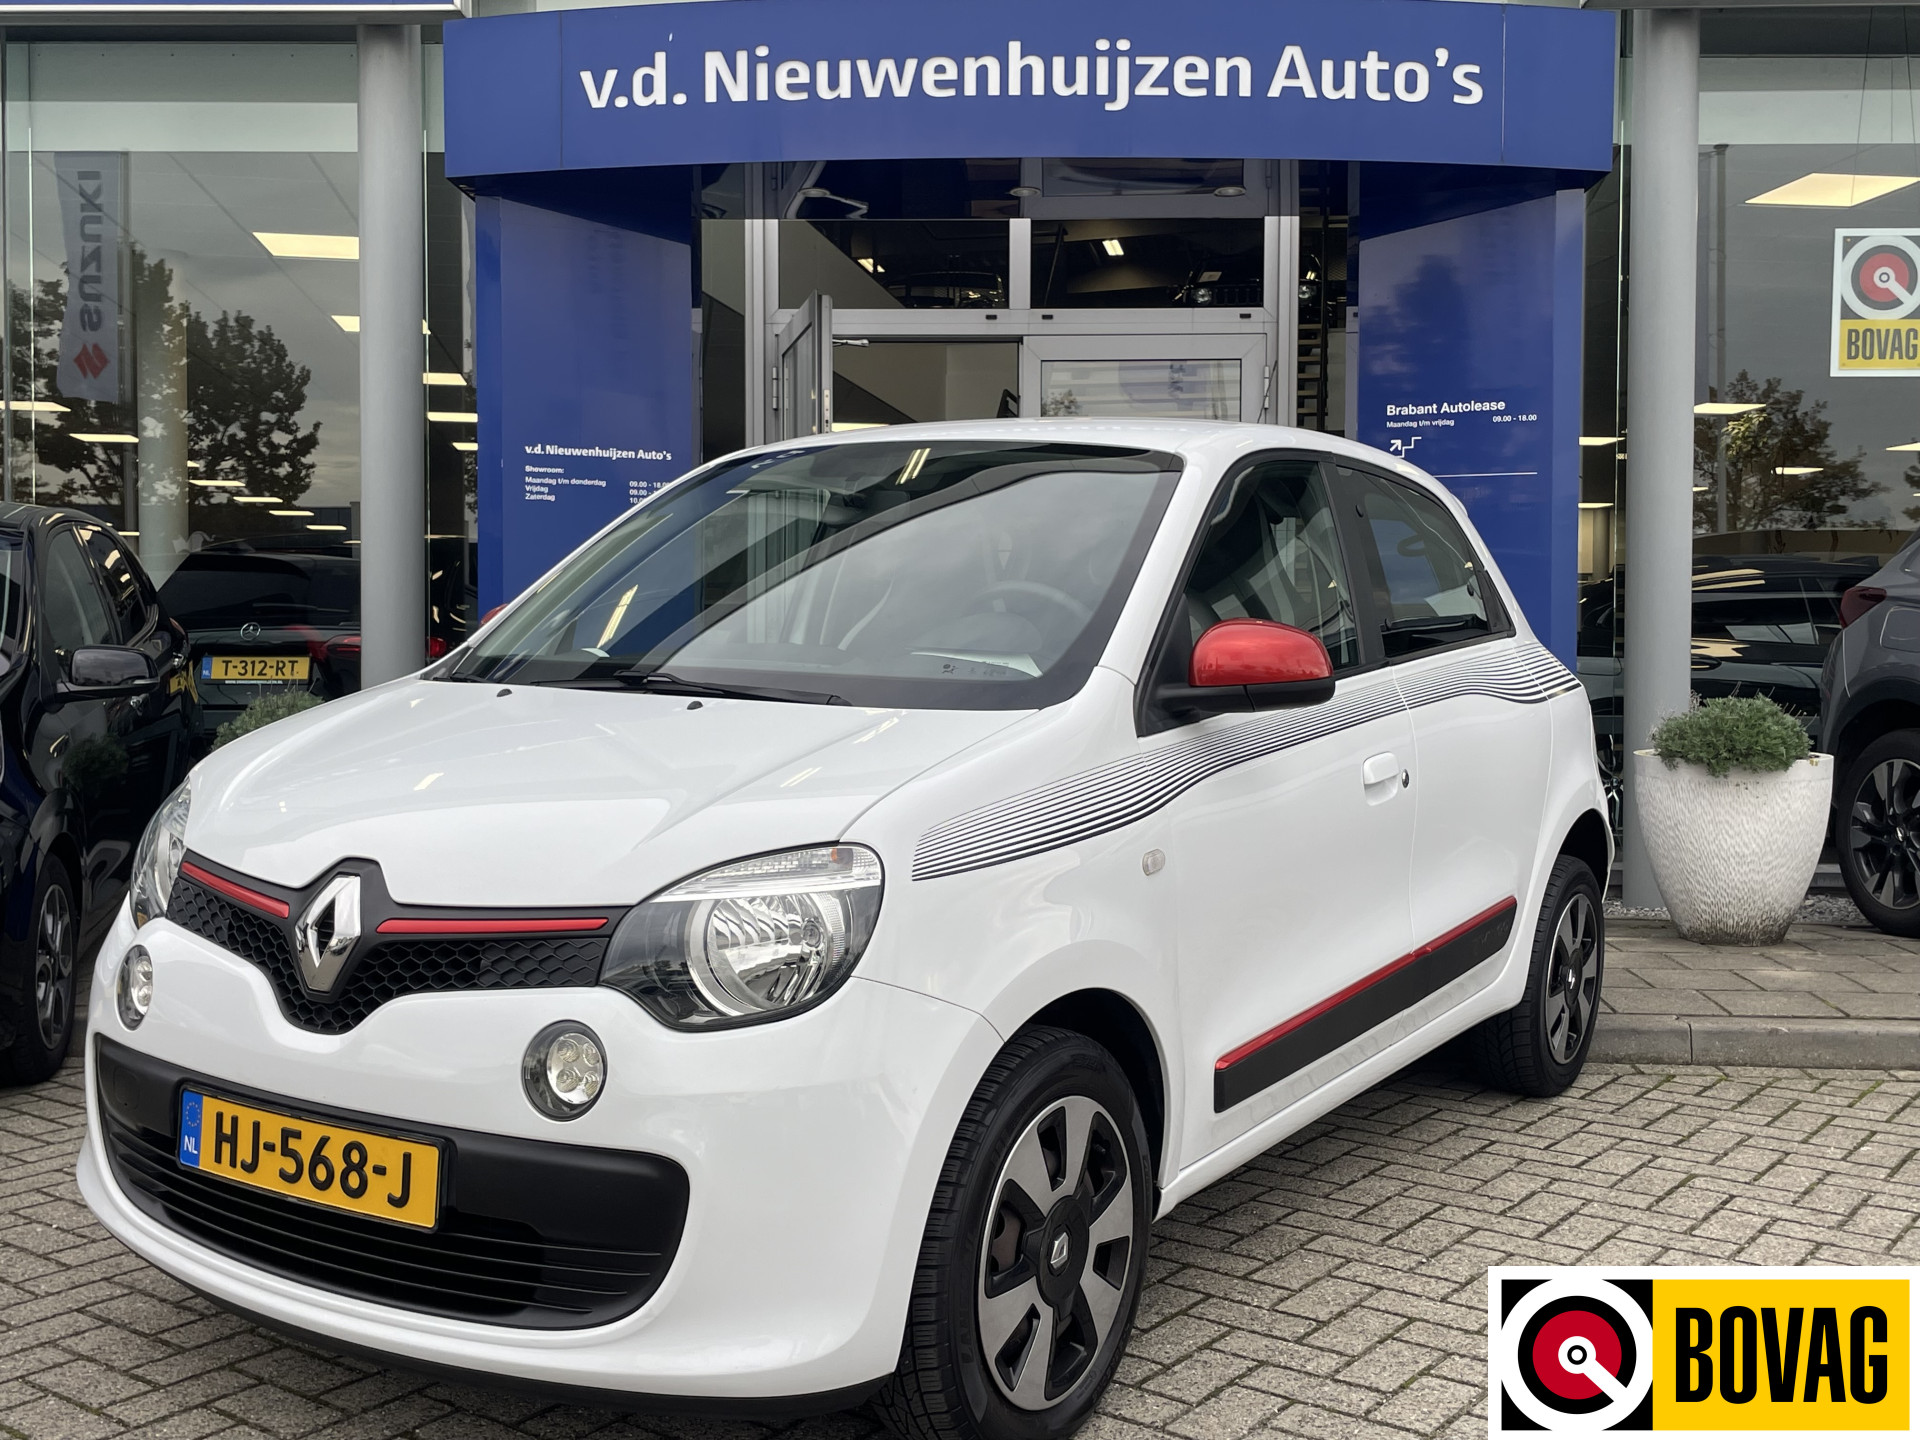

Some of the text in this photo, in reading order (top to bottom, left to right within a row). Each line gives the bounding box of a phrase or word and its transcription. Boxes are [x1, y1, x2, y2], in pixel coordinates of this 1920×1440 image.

[579, 38, 1484, 112] v.d. Nieuwenhuijzen Auto's
[1846, 327, 1919, 361] BOVAG
[1386, 400, 1506, 416] Brabant Autolease
[1386, 420, 1418, 428] Maandag
[1418, 419, 1431, 427] t/m
[1431, 418, 1455, 427] vrijdag
[1492, 415, 1512, 423] 09.00
[1518, 414, 1538, 422] 18.00
[524, 443, 673, 461] v.d. Nieuwenhuijzen Auto's
[524, 465, 565, 474] Showroom:
[524, 476, 557, 486] Maandag
[570, 478, 607, 487] donderdag
[629, 480, 648, 488] 09.00
[524, 485, 549, 494] Vrijdag
[629, 488, 648, 496] 09.00
[524, 493, 556, 502] Zaterdag
[221, 659, 299, 677] T-312-RT
[183, 1134, 199, 1155] NL
[214, 1110, 412, 1209] HJ-568-J
